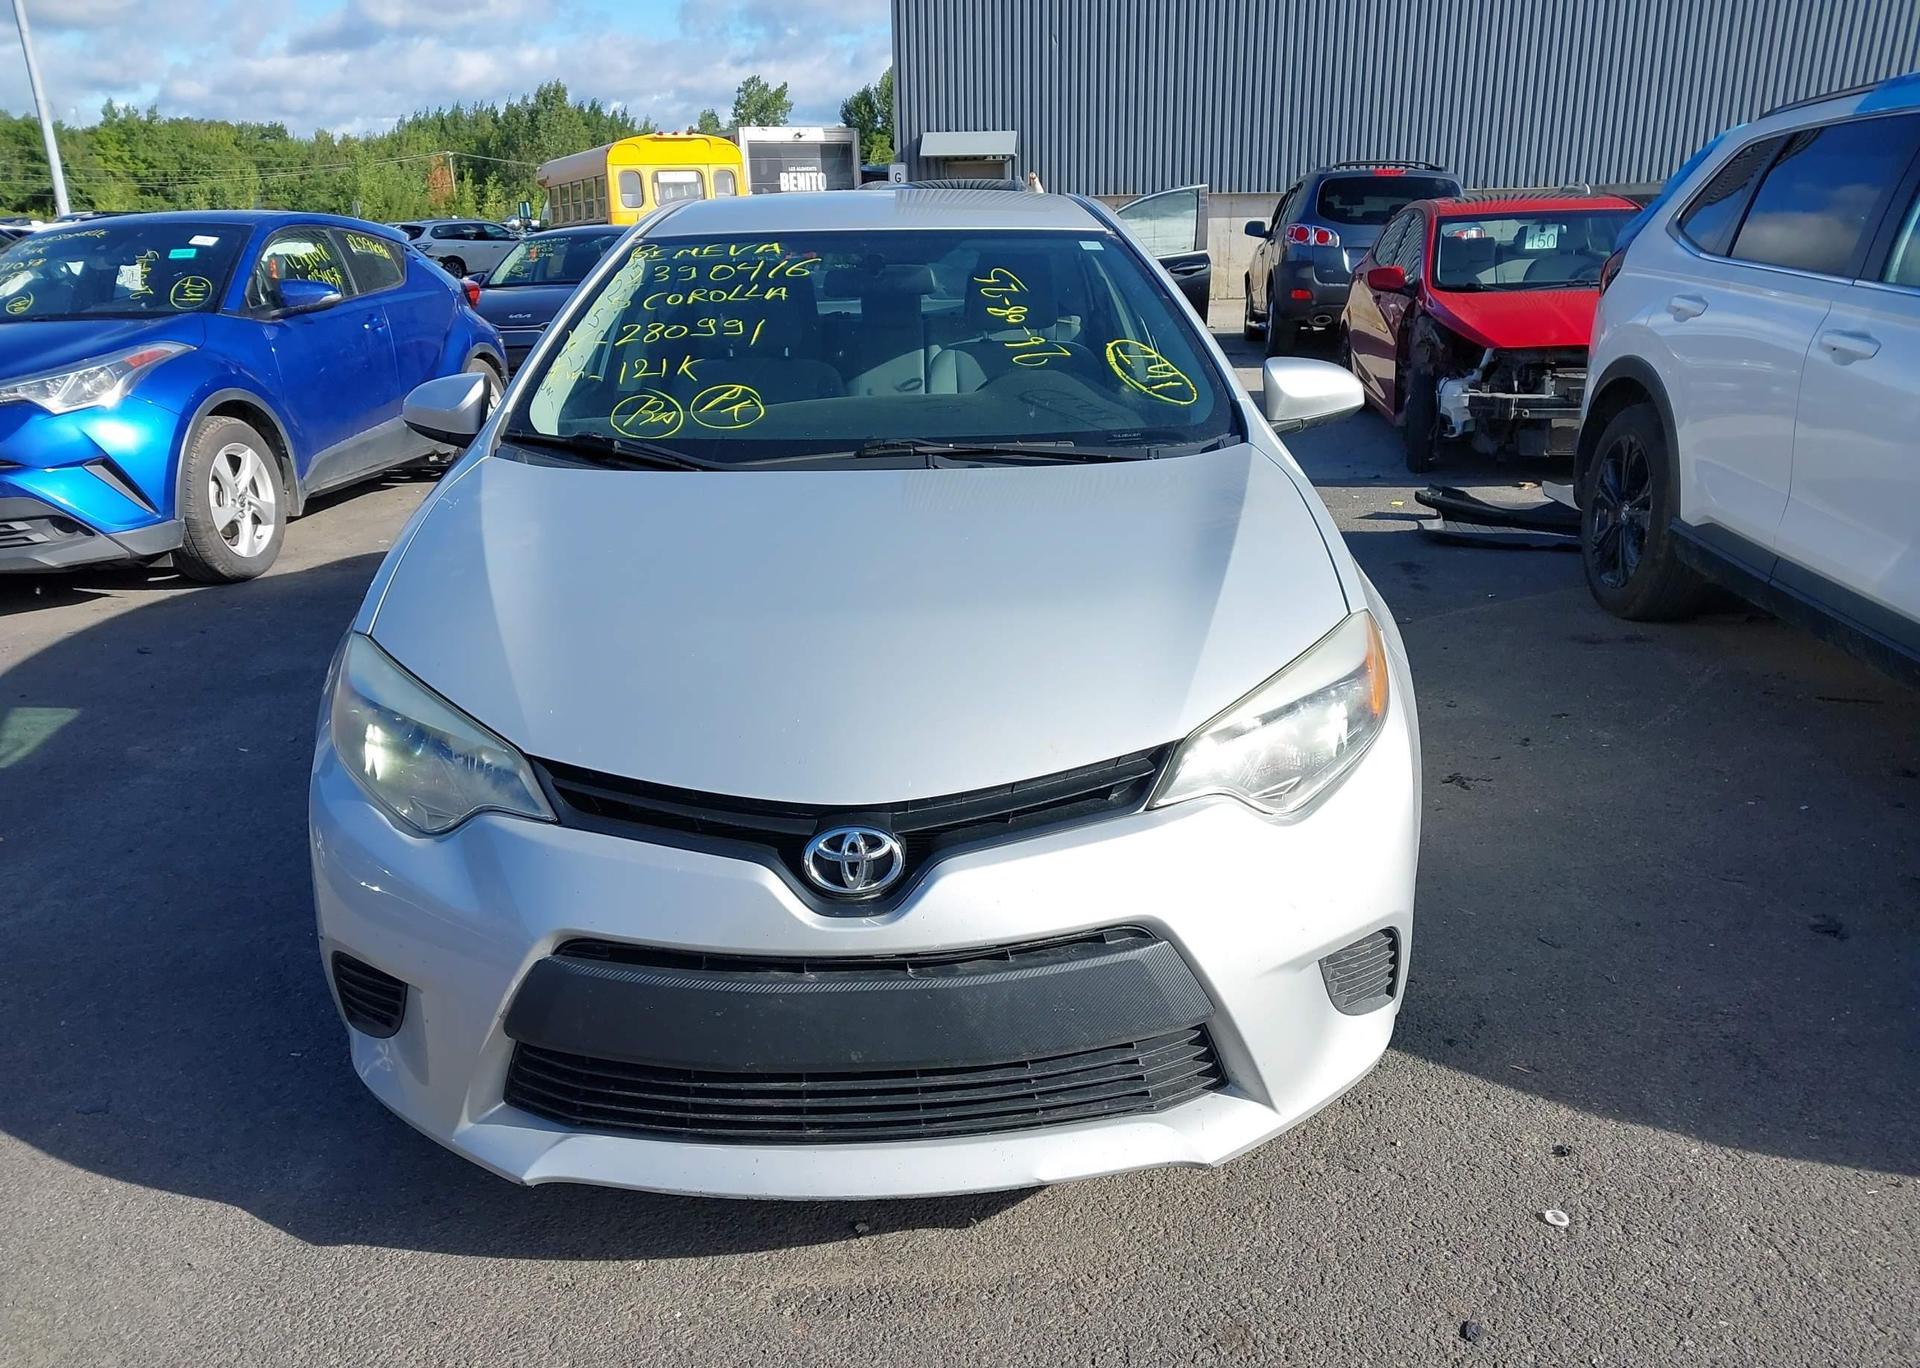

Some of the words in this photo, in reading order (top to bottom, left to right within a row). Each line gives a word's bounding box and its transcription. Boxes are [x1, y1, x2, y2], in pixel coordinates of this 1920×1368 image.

[779, 172, 827, 192] BENITO
[894, 172, 902, 183] G
[1530, 233, 1556, 248] 150
[643, 283, 789, 311] COROLLA
[615, 317, 767, 346] 280991
